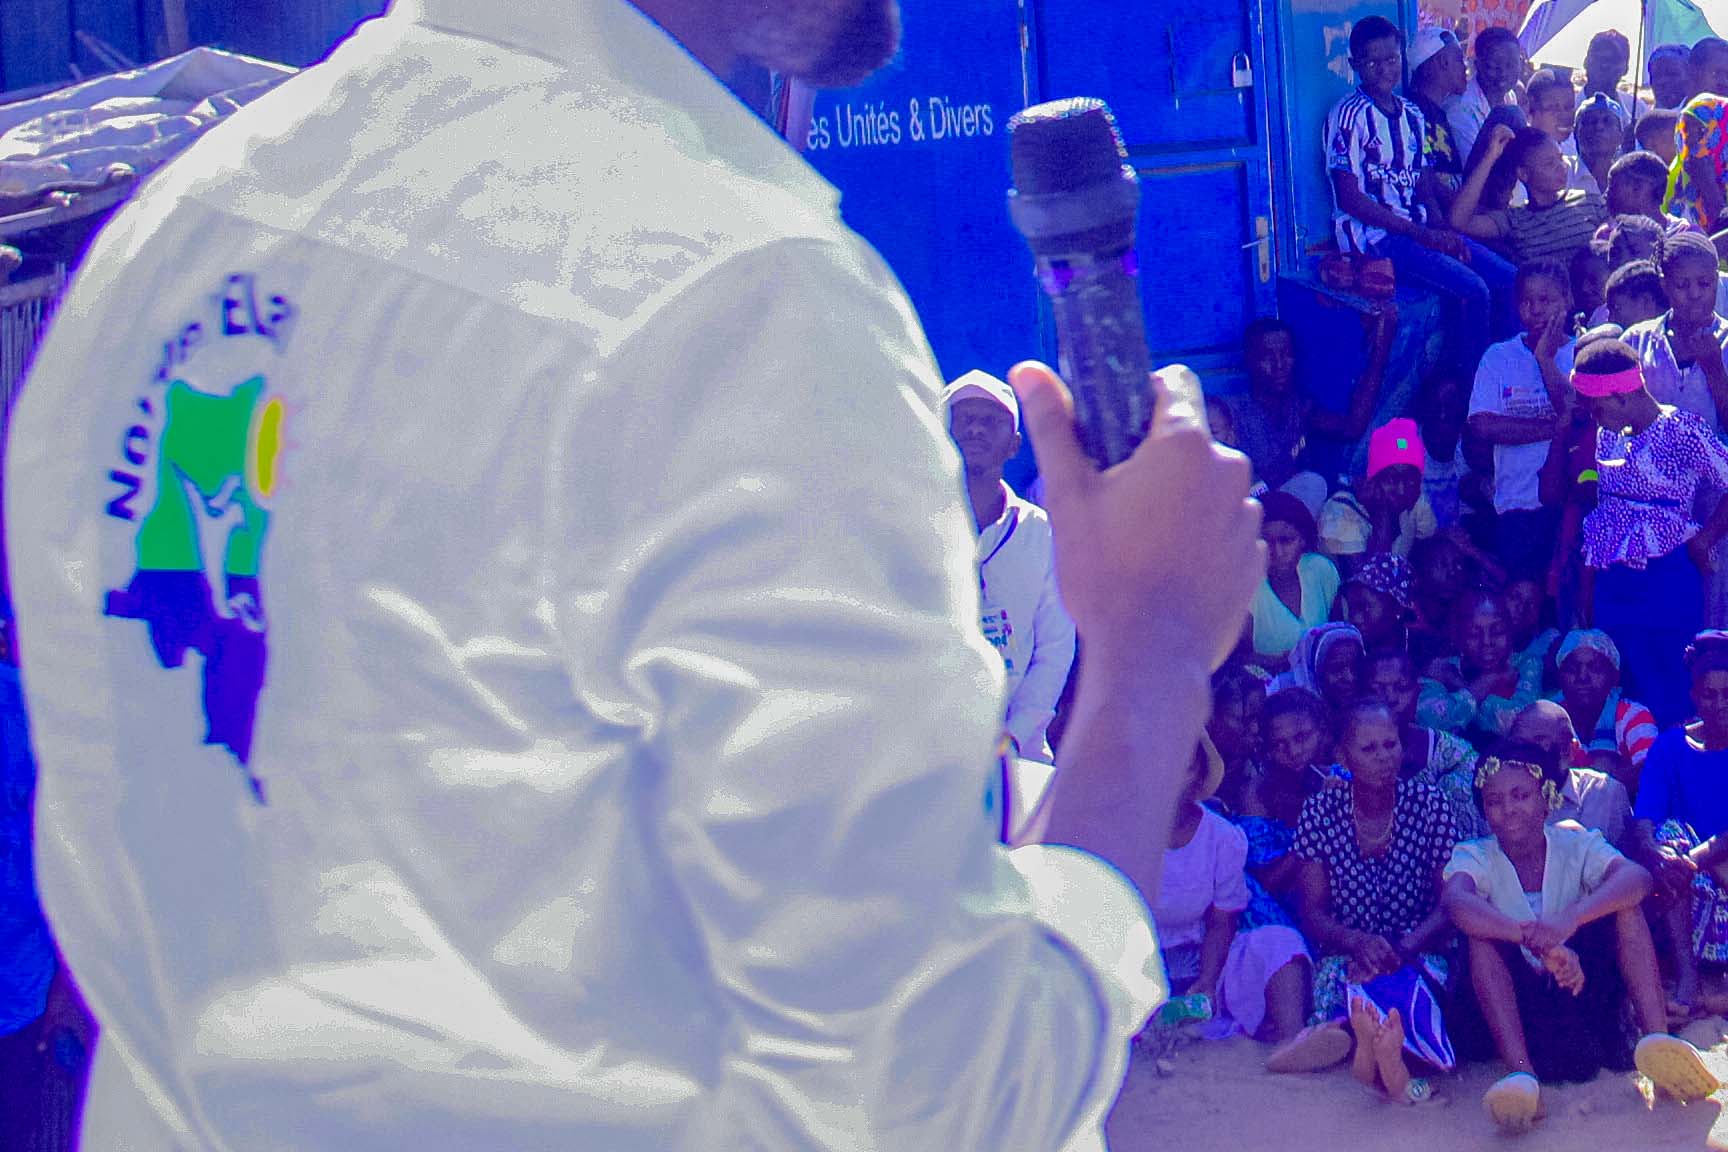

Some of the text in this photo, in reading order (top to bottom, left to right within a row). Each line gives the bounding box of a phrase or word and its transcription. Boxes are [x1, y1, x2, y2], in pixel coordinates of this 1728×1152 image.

[836, 100, 900, 147] Unités
[909, 97, 926, 141] &
[929, 95, 994, 139] Divers
